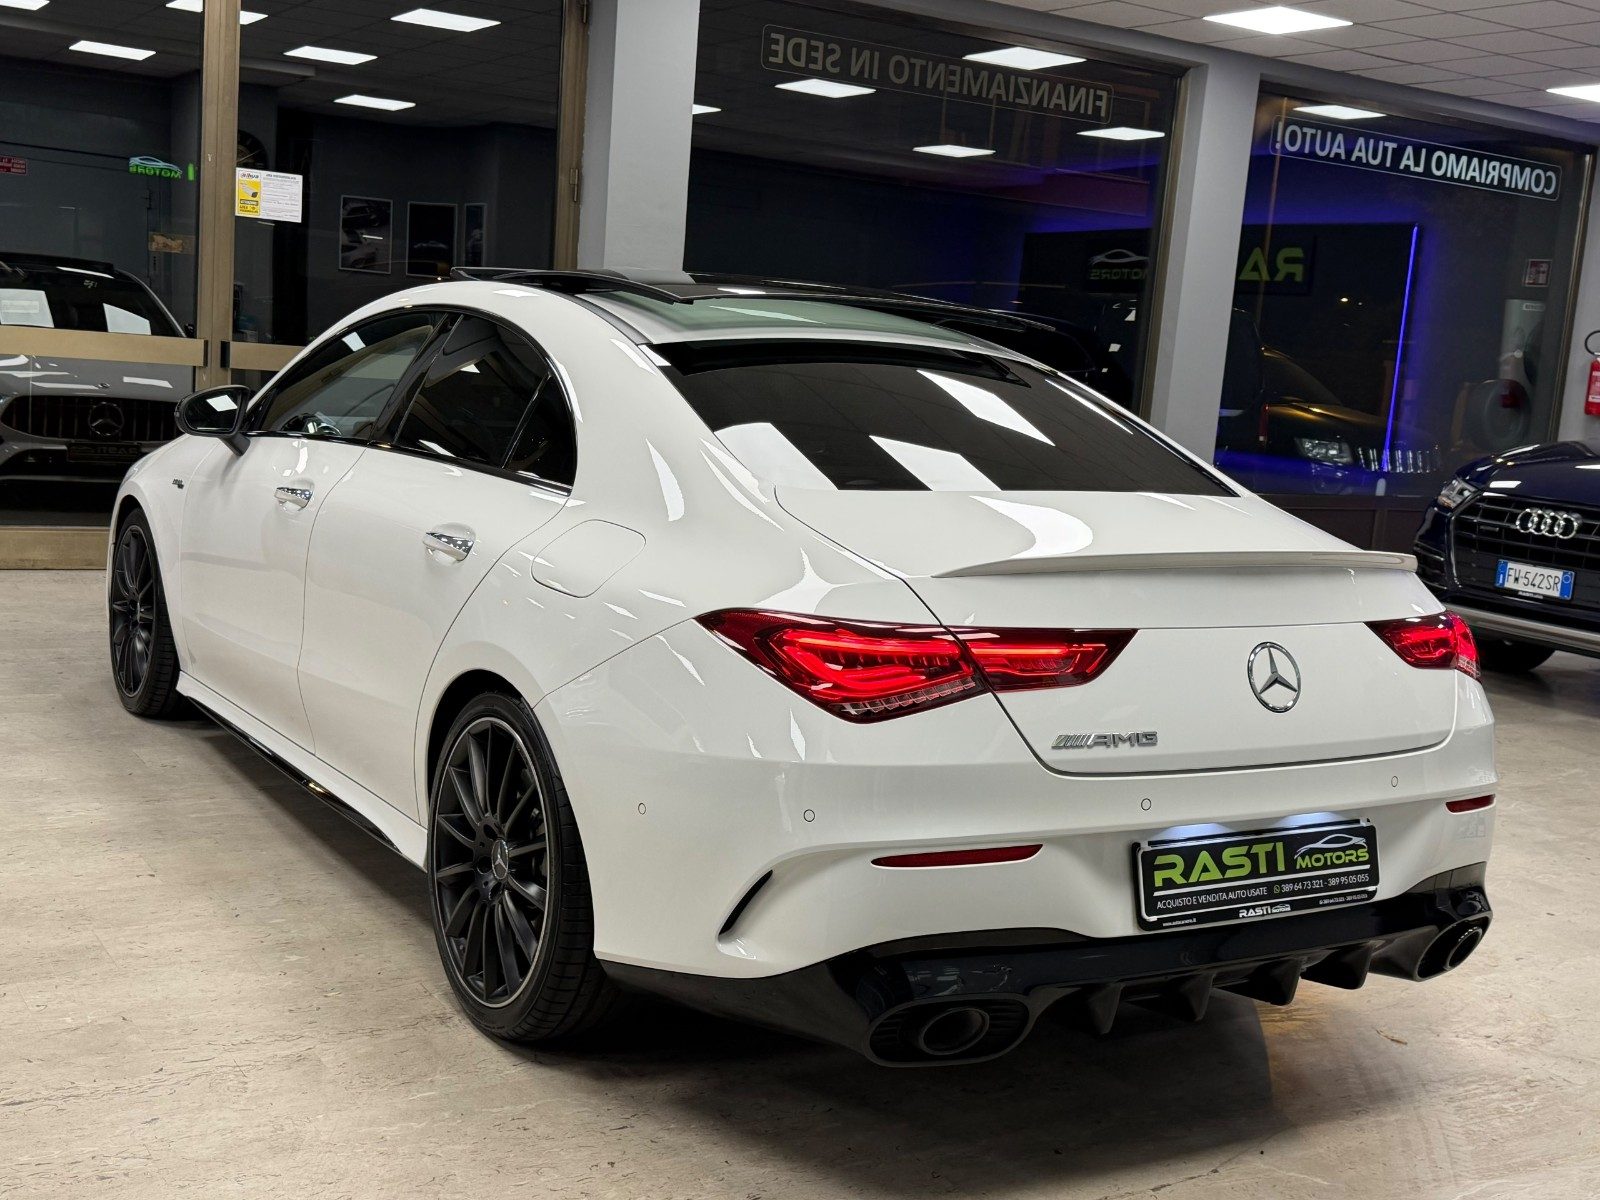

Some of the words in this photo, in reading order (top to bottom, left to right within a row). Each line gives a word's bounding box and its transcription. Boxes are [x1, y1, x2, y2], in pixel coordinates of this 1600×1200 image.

[1087, 731, 1158, 748] AMG
[1154, 842, 1285, 887] RASTI
[1296, 848, 1370, 870] MOTORS
[1157, 896, 1192, 909] ACQUISTO
[1193, 896, 1198, 904] E
[1198, 891, 1227, 904] VENDITA
[1228, 889, 1247, 899] AUTO
[1247, 887, 1267, 897] USATE
[1281, 883, 1294, 892] 389
[1294, 882, 1303, 891] 64
[1303, 881, 1312, 889] 73
[1312, 879, 1324, 888] 321
[1328, 877, 1340, 886] 389
[1340, 876, 1349, 885] 95
[1357, 873, 1370, 883] 055
[1239, 905, 1272, 918] RASTI
